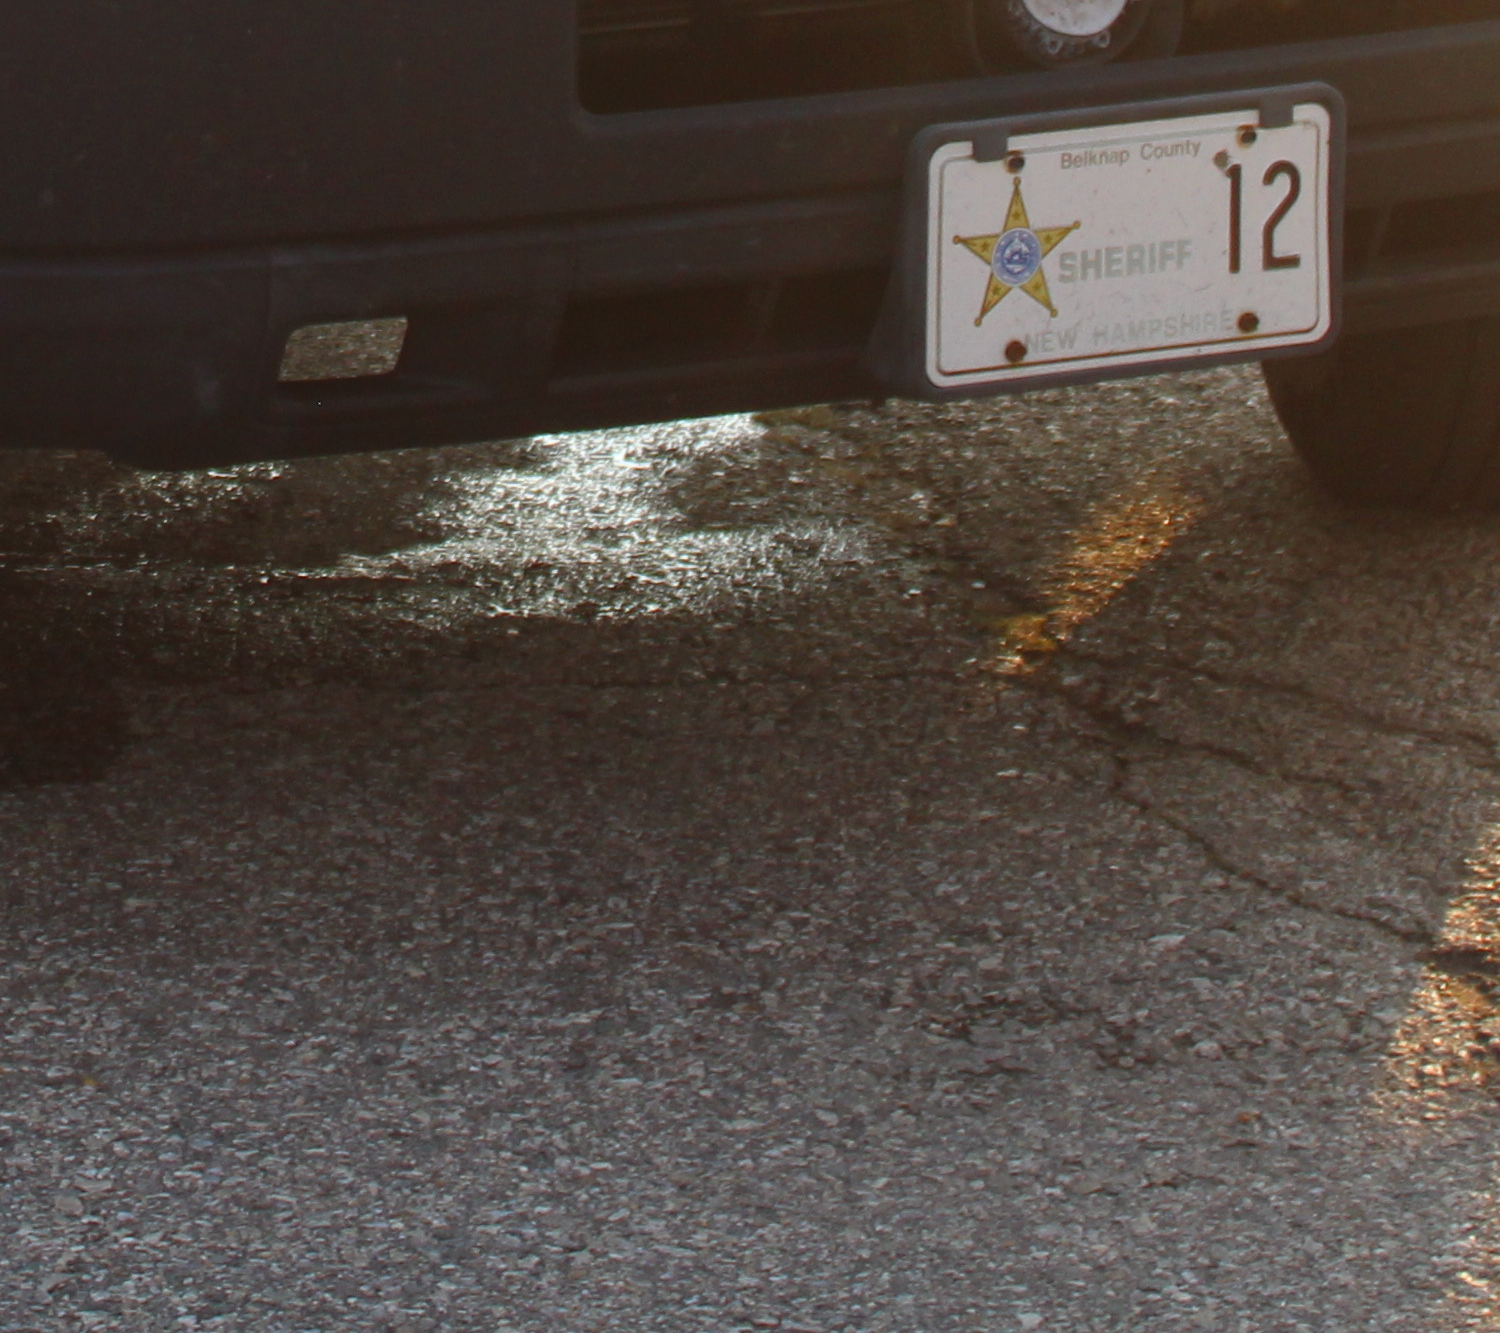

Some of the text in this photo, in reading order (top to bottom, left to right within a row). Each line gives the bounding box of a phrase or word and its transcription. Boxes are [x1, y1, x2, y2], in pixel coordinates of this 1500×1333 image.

[1060, 139, 1201, 170] Belknap County
[1226, 160, 1300, 274] 12
[1058, 239, 1192, 283] SHERIFF
[1024, 309, 1235, 354] NEW HAMPSHIRE
